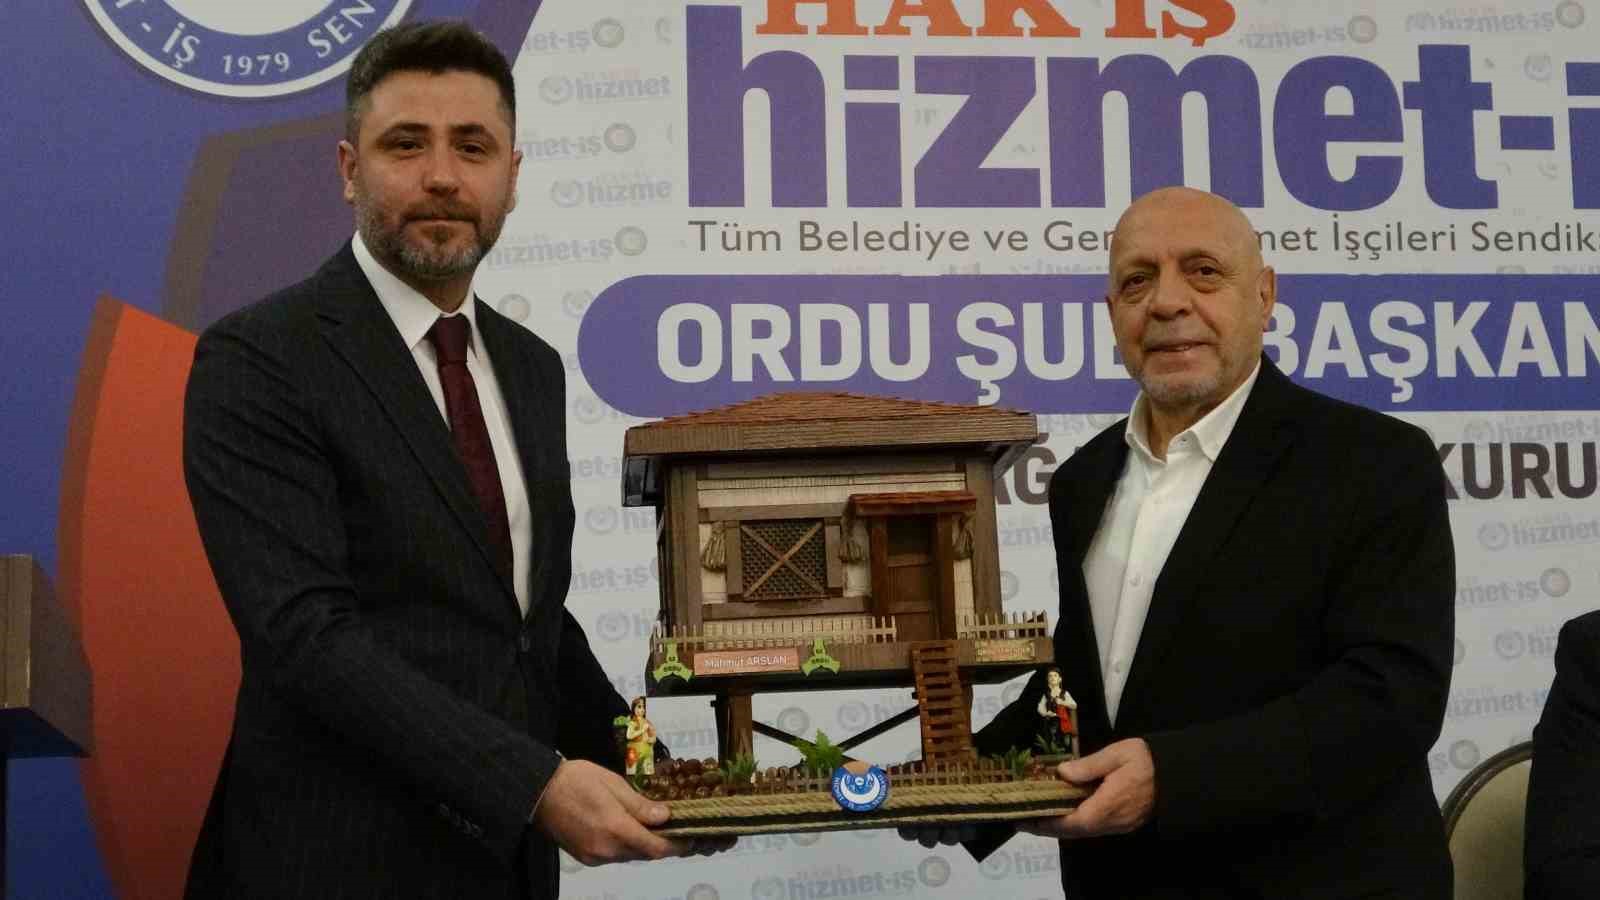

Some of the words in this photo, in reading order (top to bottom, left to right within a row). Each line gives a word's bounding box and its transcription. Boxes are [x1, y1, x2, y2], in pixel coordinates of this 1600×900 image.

[223, 52, 290, 76] 1979
[688, 221, 782, 251] Tüm
[800, 220, 970, 260] Belediye
[984, 230, 1028, 251] ve
[1332, 213, 1456, 260] İşçileri
[1472, 221, 1600, 251] Sendik
[657, 303, 931, 382] ORDU
[747, 655, 786, 666] ARSLAN
